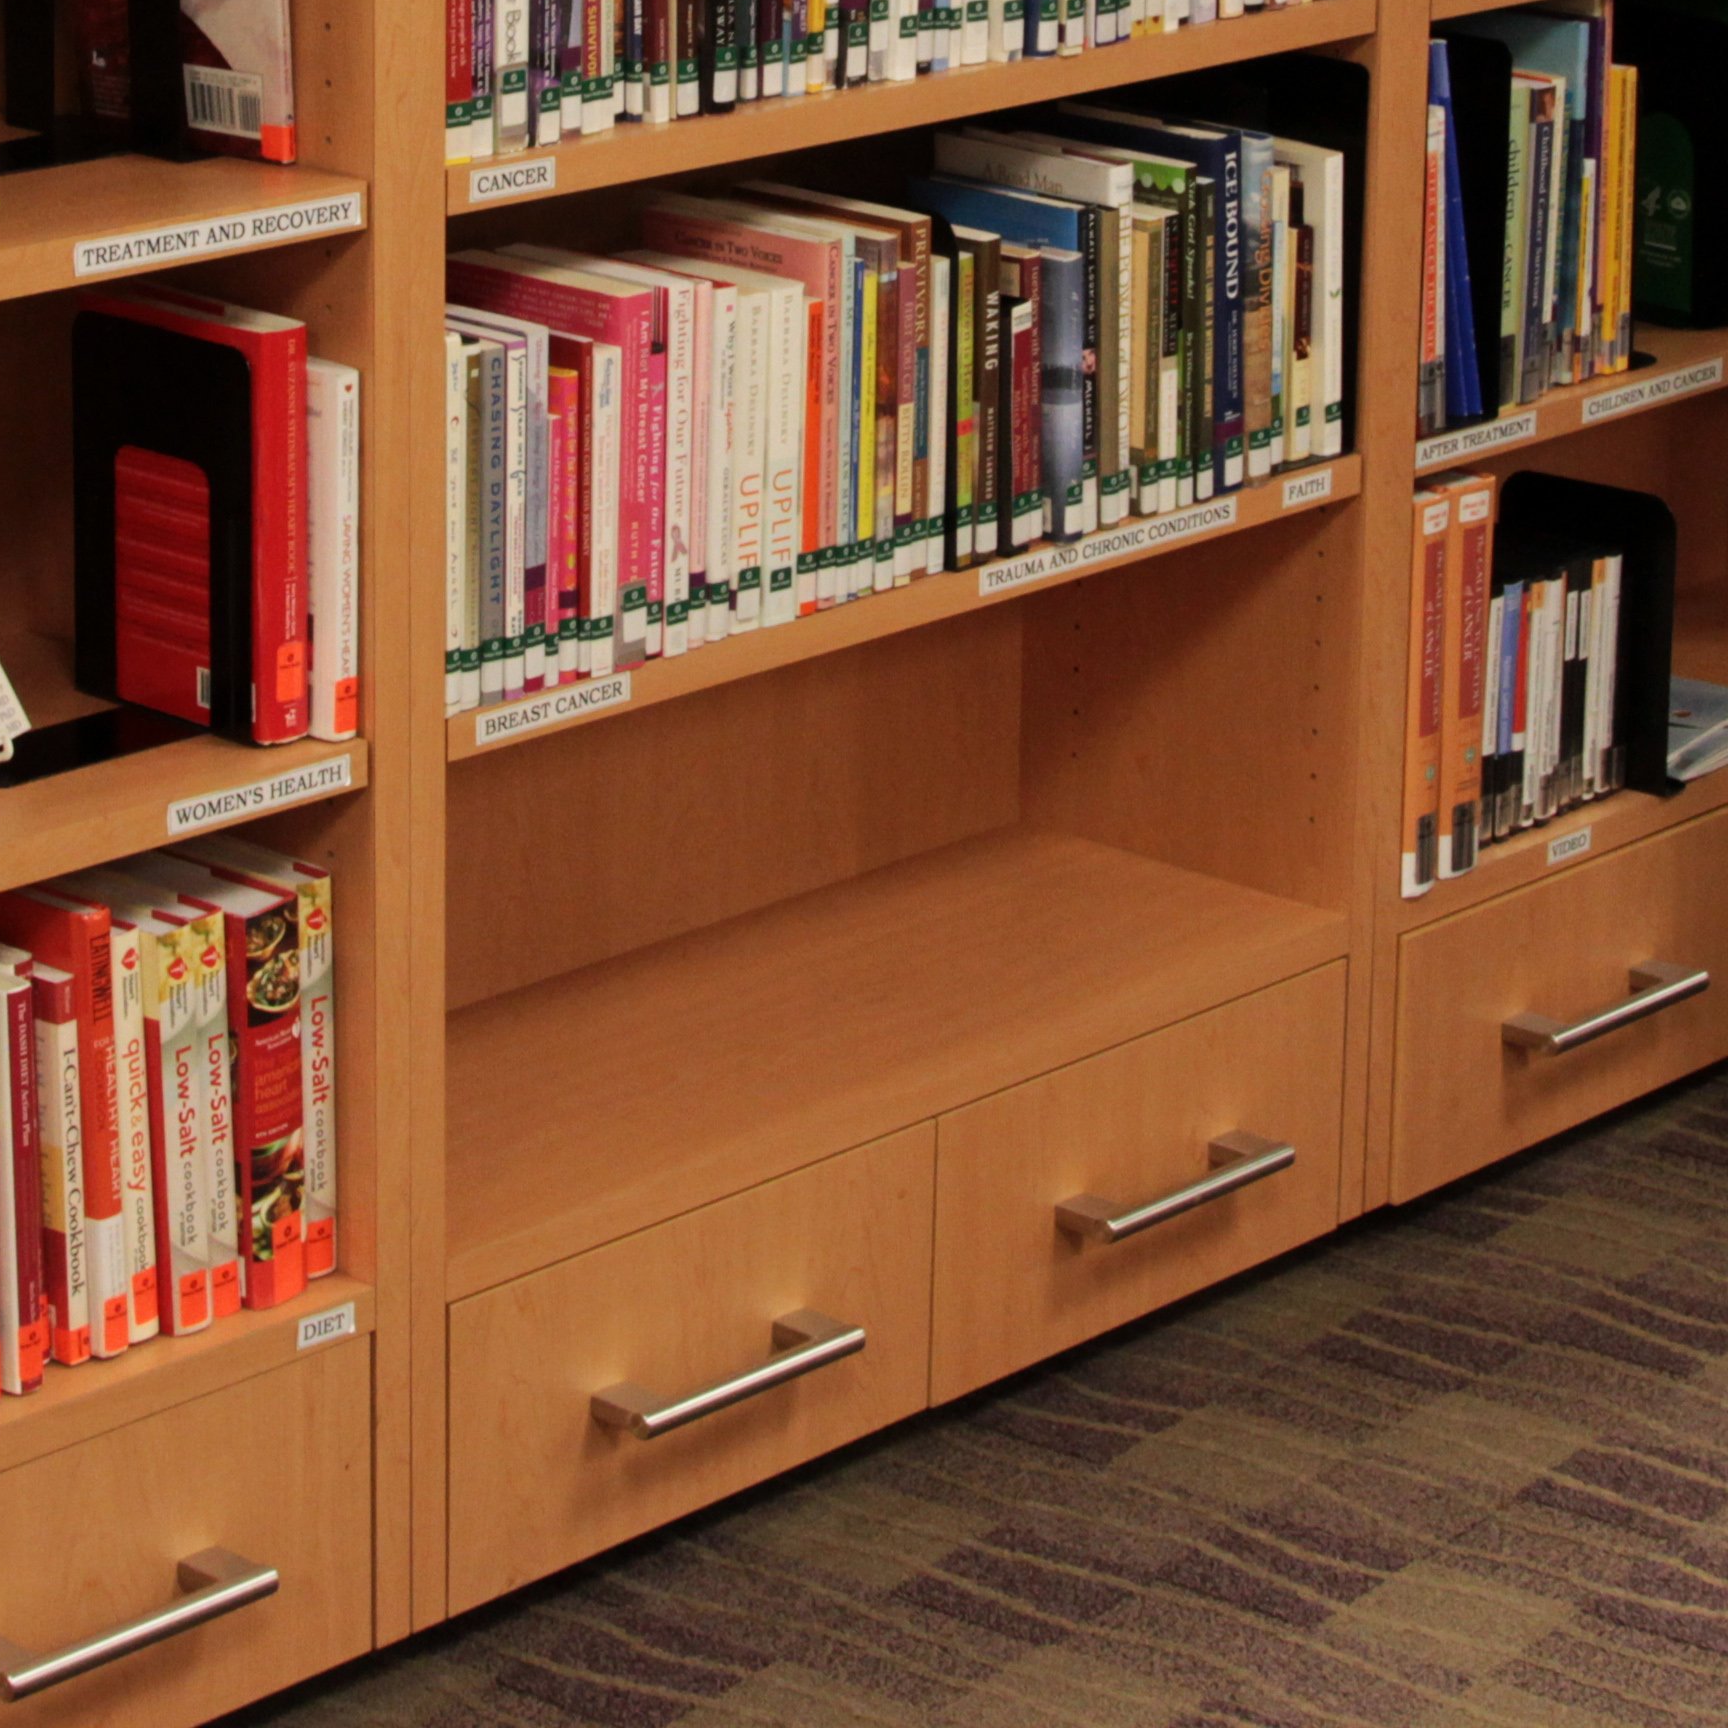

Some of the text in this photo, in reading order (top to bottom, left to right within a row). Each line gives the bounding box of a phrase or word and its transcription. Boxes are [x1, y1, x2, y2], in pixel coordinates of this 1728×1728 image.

[477, 166, 549, 194] CANCER
[1507, 139, 1521, 220] children
[83, 201, 353, 267] TREATMENT AND RECOVERY
[1224, 151, 1239, 300] ICE BOUND
[984, 290, 1000, 371] WAKING
[1588, 364, 1718, 418] CHILDREN AND CANCER
[1421, 417, 1532, 461] AFTER TREATMENT
[489, 357, 501, 604] CHASING DAYLIGHT
[1287, 476, 1327, 500] FAITH
[987, 503, 1231, 588] TRAUMA AND CHRONIC CONDITIONS
[484, 682, 623, 736] BREAST CANCER
[175, 765, 343, 827] WOMEN'S HEALTH
[1550, 832, 1588, 858] VIDEO
[208, 1033, 227, 1232] Low-Salt cookbook
[311, 995, 331, 1192] Low-Salt cookbook
[62, 1049, 83, 1297] I-Can't-Chew Cookbook
[123, 1038, 149, 1271] quick & easy cookbook
[175, 1045, 196, 1246] Low-Salt cookbook
[302, 1314, 346, 1342] DIET
